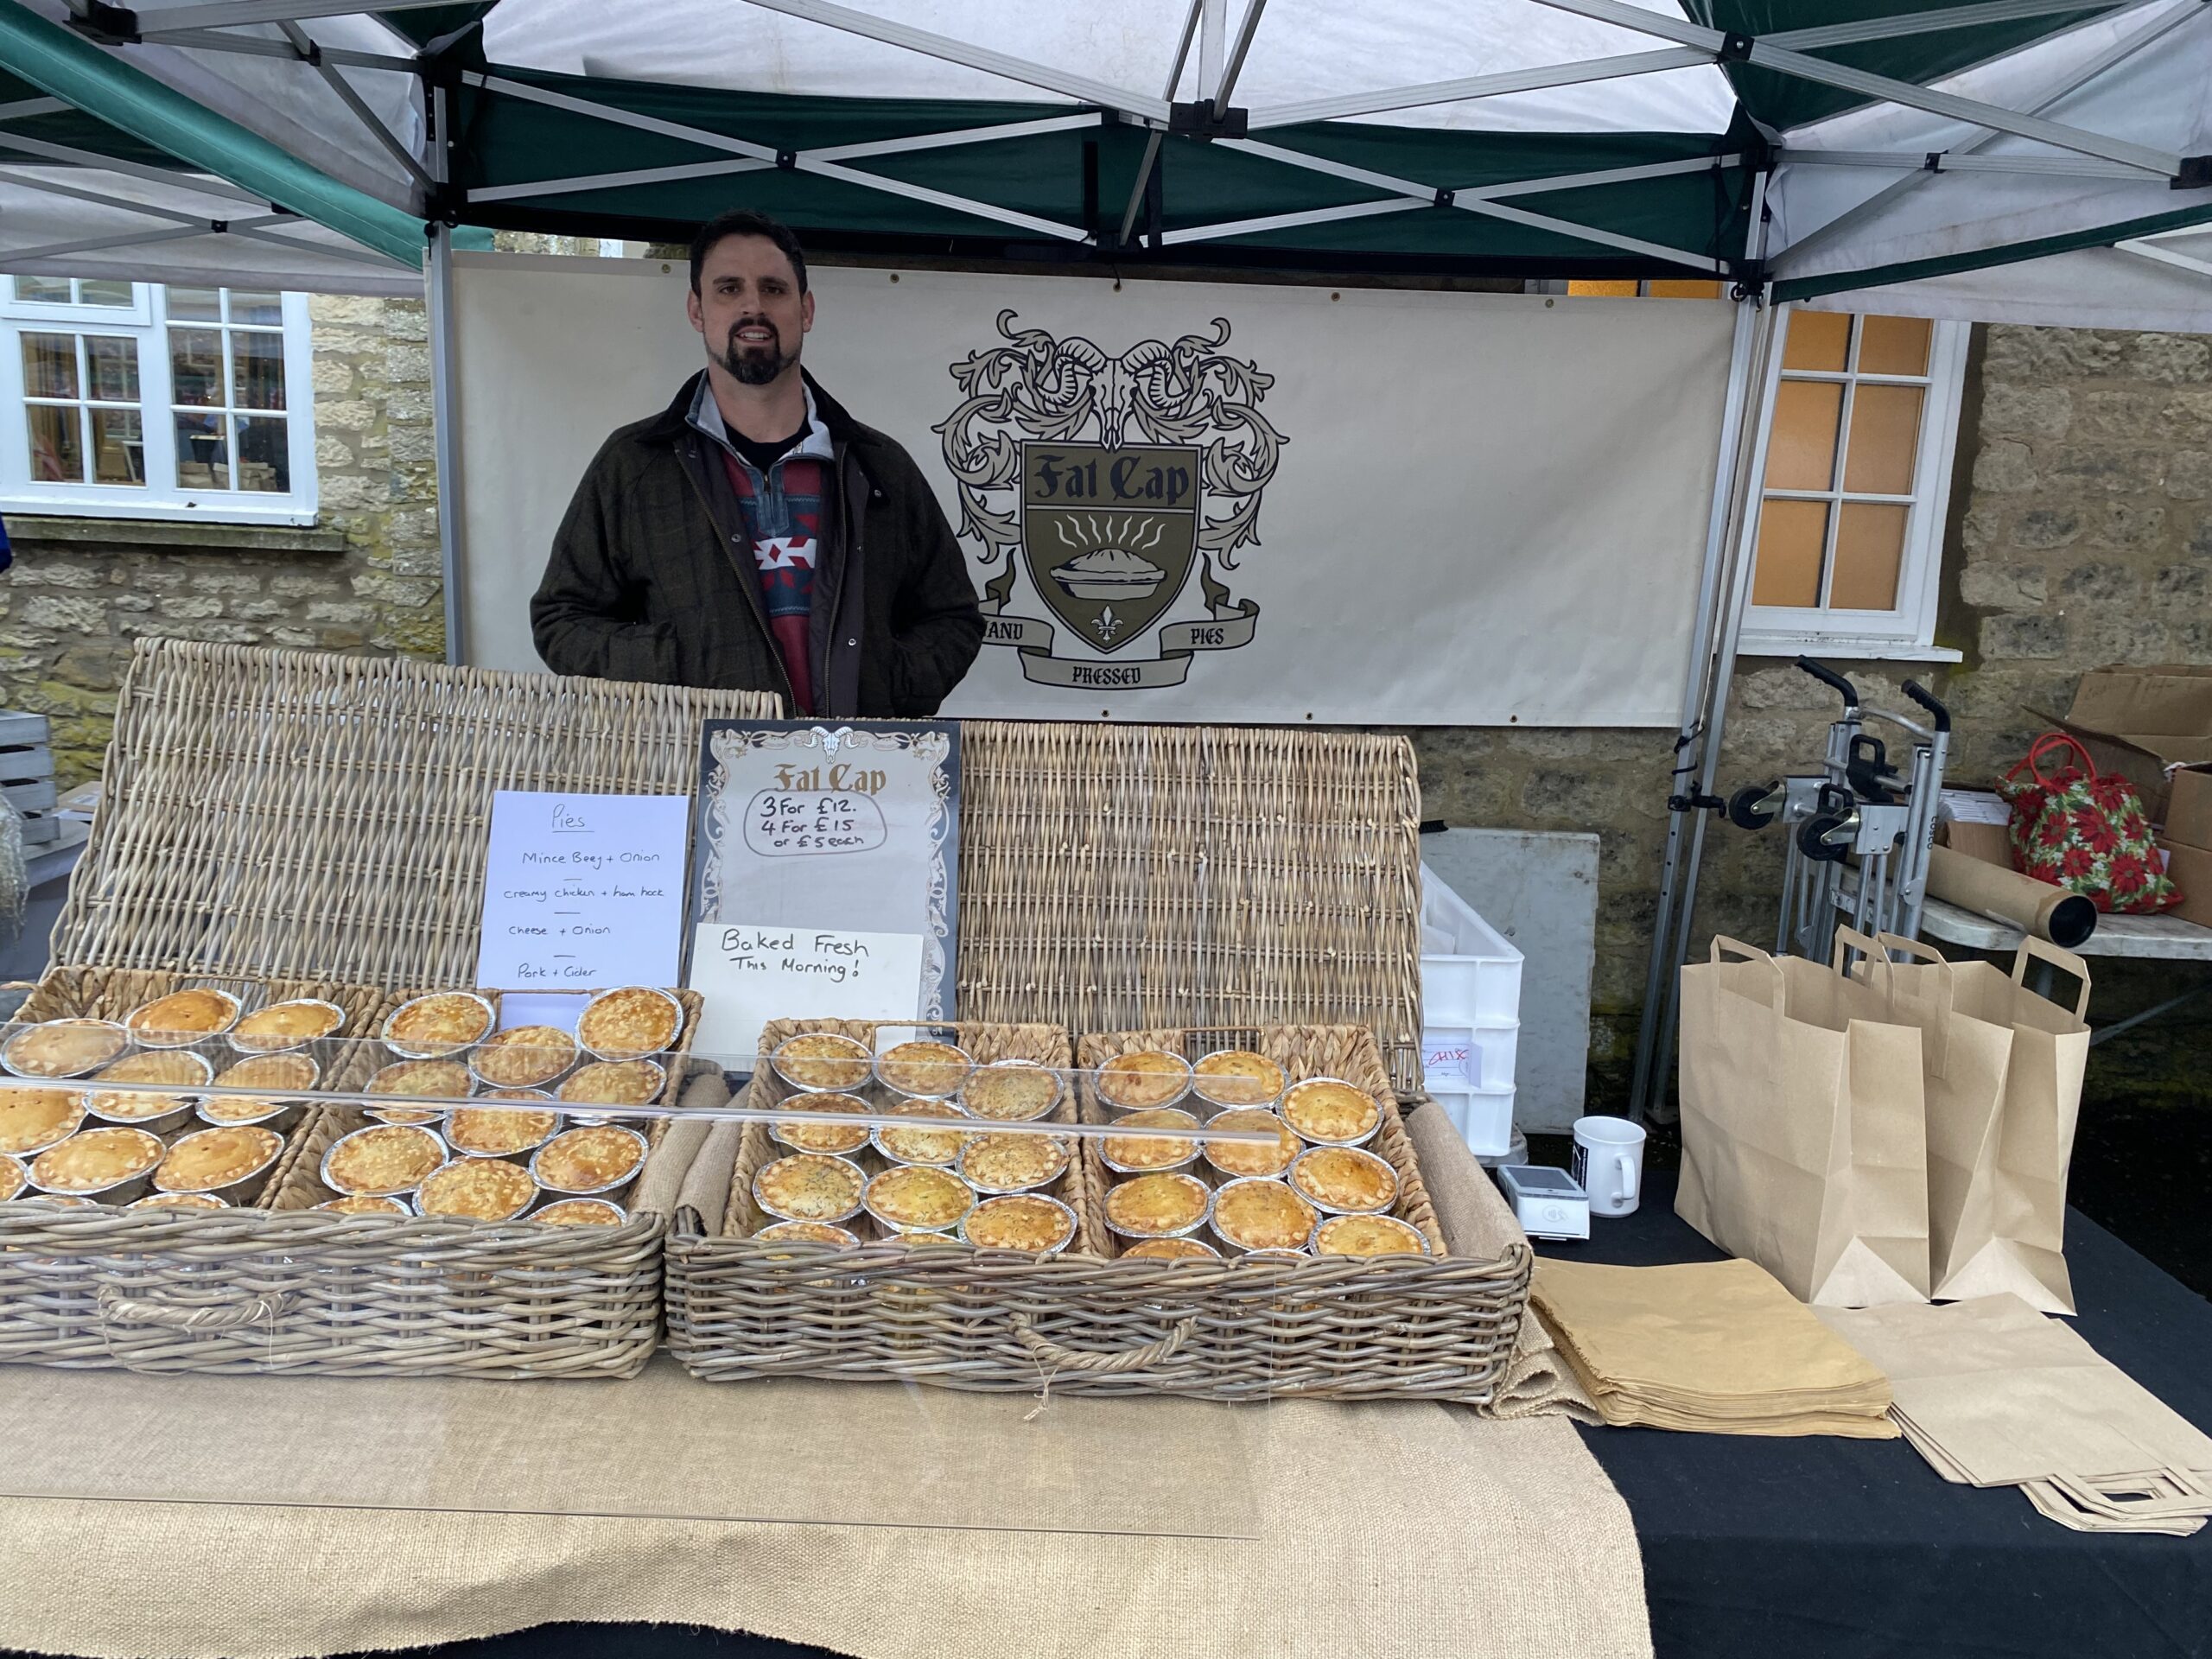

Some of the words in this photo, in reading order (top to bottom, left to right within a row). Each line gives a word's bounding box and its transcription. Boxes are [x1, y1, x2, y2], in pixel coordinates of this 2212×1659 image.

[1033, 454, 1097, 499] Fat
[1109, 454, 1190, 506] Cap
[982, 620, 1025, 640] AND
[1190, 627, 1224, 645] PIES
[1071, 665, 1141, 685] PRESSED
[773, 763, 820, 792] Fat
[828, 762, 887, 796] Cap
[551, 803, 586, 829] Pies
[760, 796, 777, 817] 3
[779, 797, 805, 816] For
[760, 820, 776, 836] 4
[781, 819, 808, 834] For
[773, 837, 790, 848] or
[827, 836, 865, 848] each
[521, 851, 567, 864] Mince
[606, 855, 614, 863] +
[619, 849, 661, 862] Onion
[613, 884, 636, 898] ham
[640, 886, 664, 898] hock
[572, 923, 612, 936] Onion
[721, 928, 795, 952] Baked
[814, 934, 870, 957] Fresh
[518, 962, 548, 979] Pork
[563, 965, 598, 978] Cider
[729, 956, 767, 971] This
[781, 957, 861, 983] Morning!
